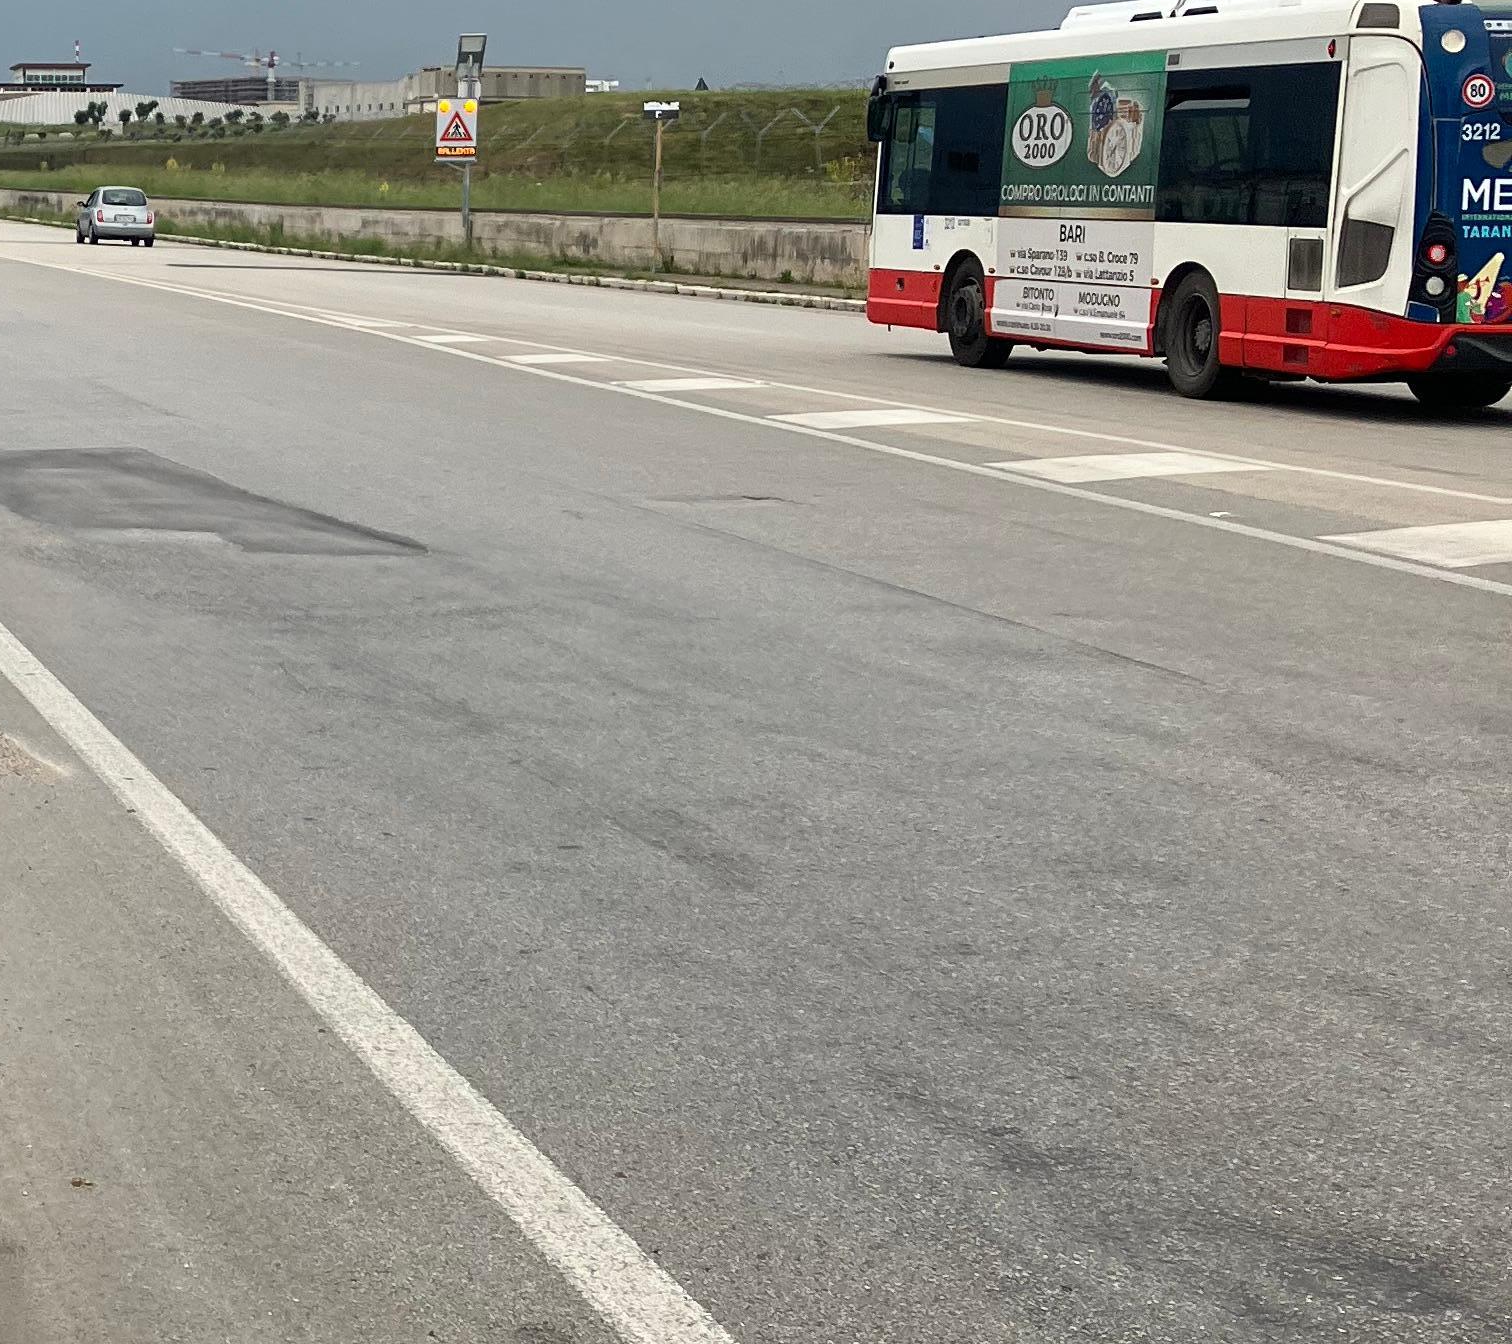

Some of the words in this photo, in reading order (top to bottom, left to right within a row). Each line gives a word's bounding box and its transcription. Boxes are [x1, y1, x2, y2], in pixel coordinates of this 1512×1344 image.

[1470, 83, 1486, 98] 80
[1019, 112, 1066, 142] ORO
[1462, 122, 1501, 141] 3212
[1023, 142, 1056, 159] 2000
[1001, 184, 1043, 201] COMPRO
[1043, 184, 1087, 202] OROLOGI
[1088, 185, 1101, 202] IN
[1101, 184, 1155, 203] CONTANTI
[1059, 224, 1086, 243] BARI
[1106, 251, 1128, 264] Croce
[1129, 252, 1139, 265] 79
[1129, 270, 1135, 282] 5
[1022, 286, 1055, 302] BITONTO
[1078, 291, 1121, 308] MODUGNO
